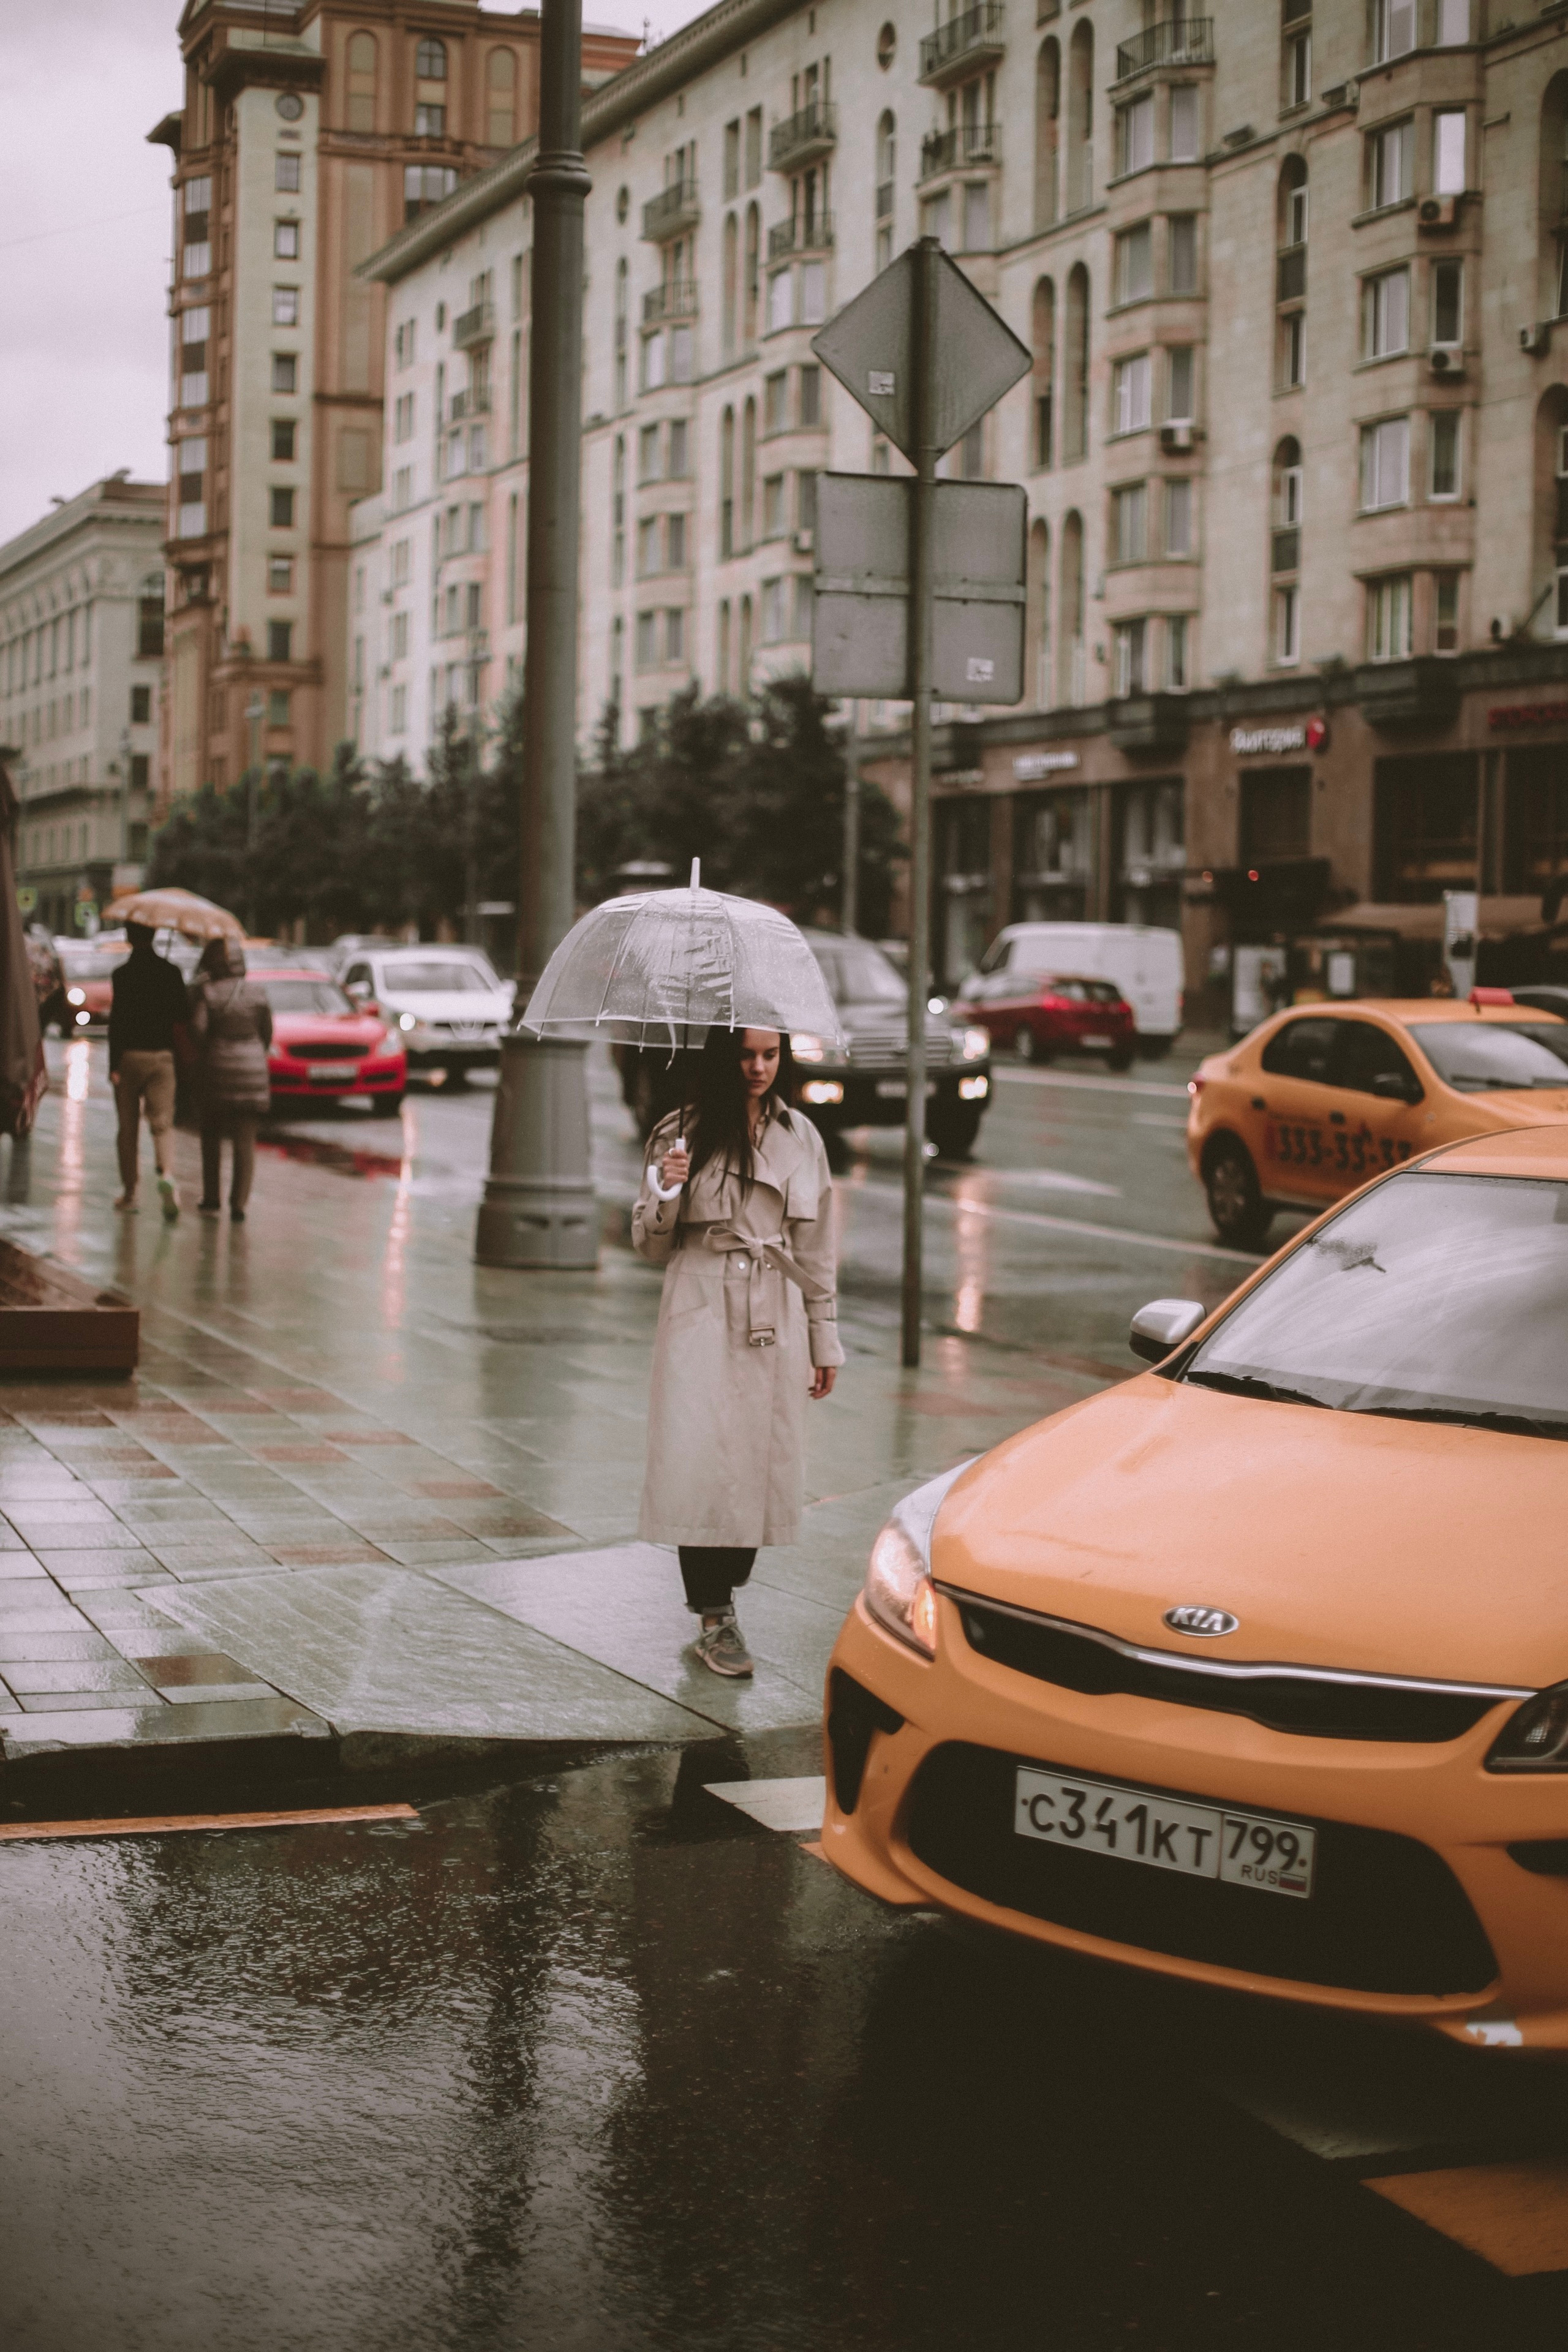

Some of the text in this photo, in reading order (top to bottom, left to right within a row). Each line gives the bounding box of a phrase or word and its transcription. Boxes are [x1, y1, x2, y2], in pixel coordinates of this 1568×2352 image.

[1170, 1607, 1223, 1631] KIA
[1226, 1819, 1299, 1871] 799
[1241, 1864, 1278, 1885] RUS
